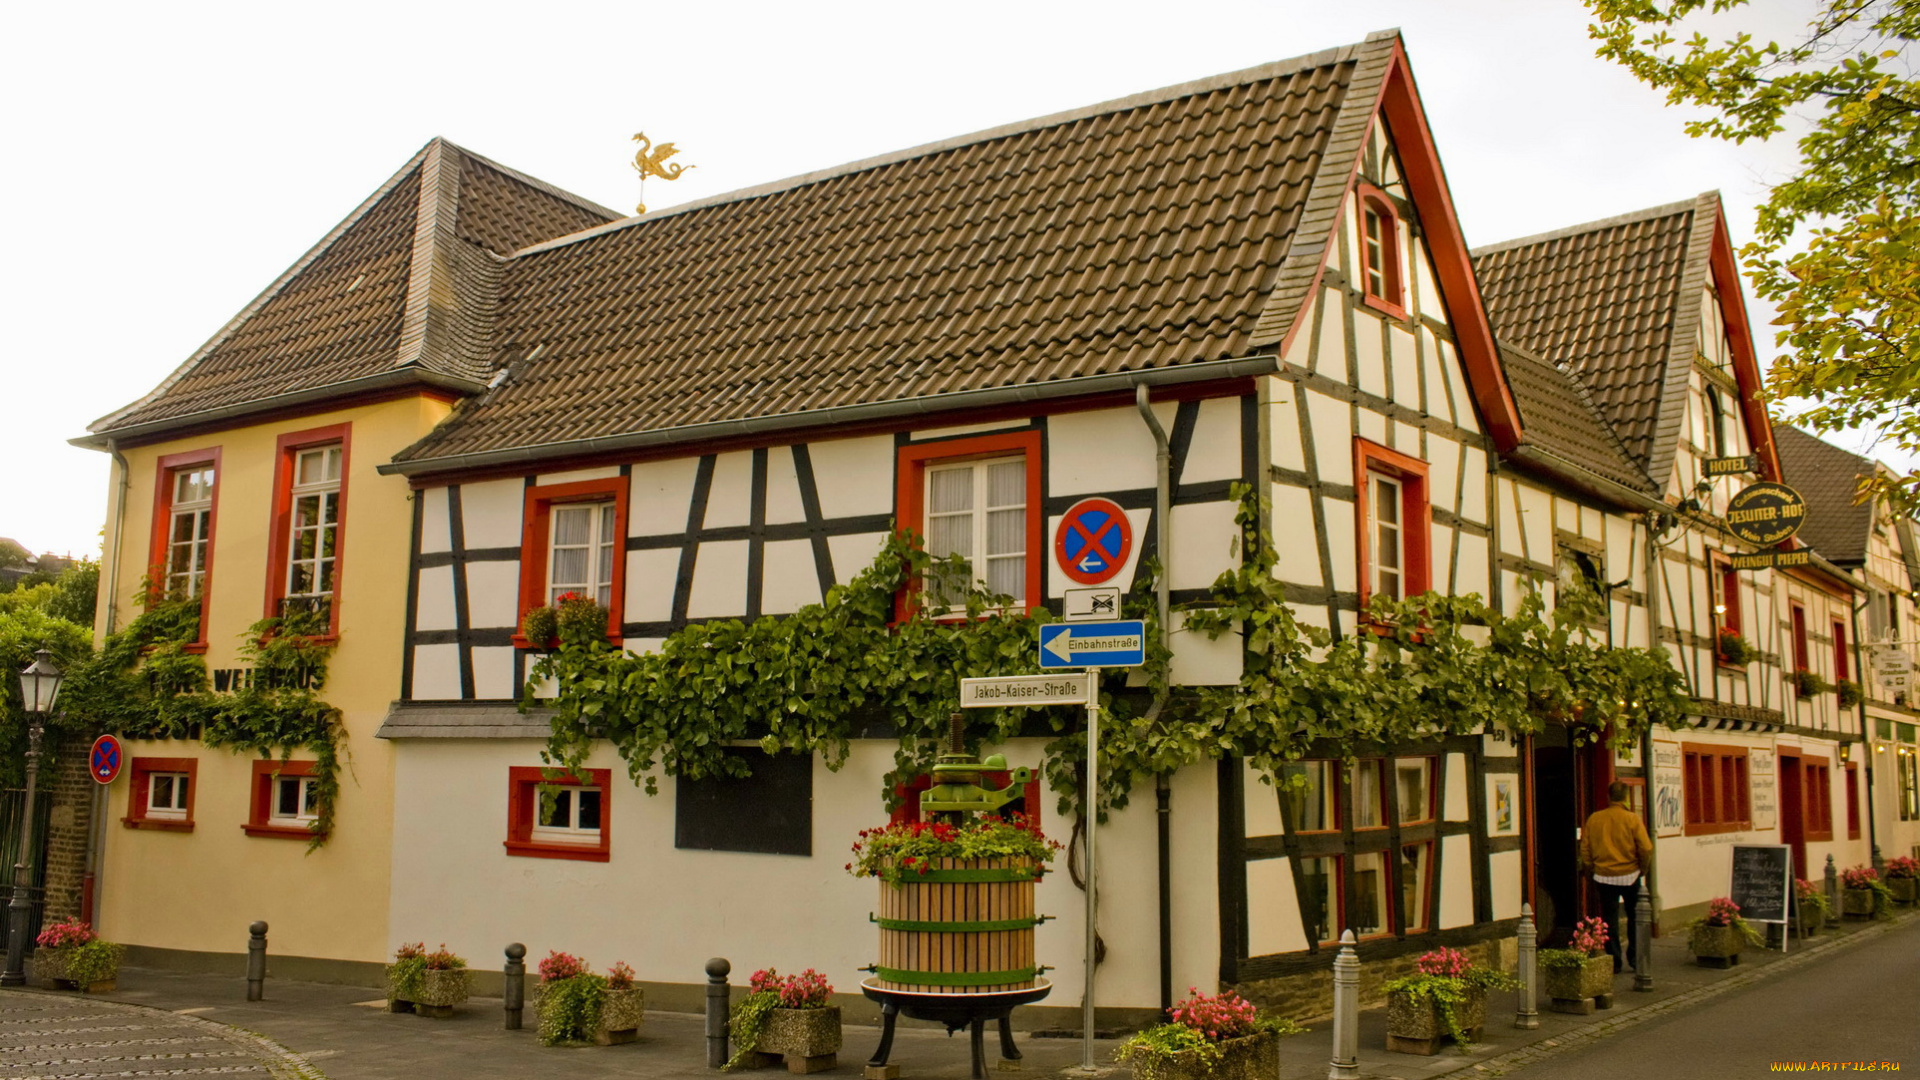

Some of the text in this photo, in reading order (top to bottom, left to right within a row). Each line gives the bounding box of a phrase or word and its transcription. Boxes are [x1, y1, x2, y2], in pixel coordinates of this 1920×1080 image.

[1710, 458, 1748, 473] HOTEL
[1741, 525, 1794, 543] Wein Stuben
[1731, 552, 1809, 569] WEINGUT PIEPER
[1068, 637, 1139, 650] Einbahnstraße
[974, 681, 1077, 699] Jakob-Kaiser-Straße
